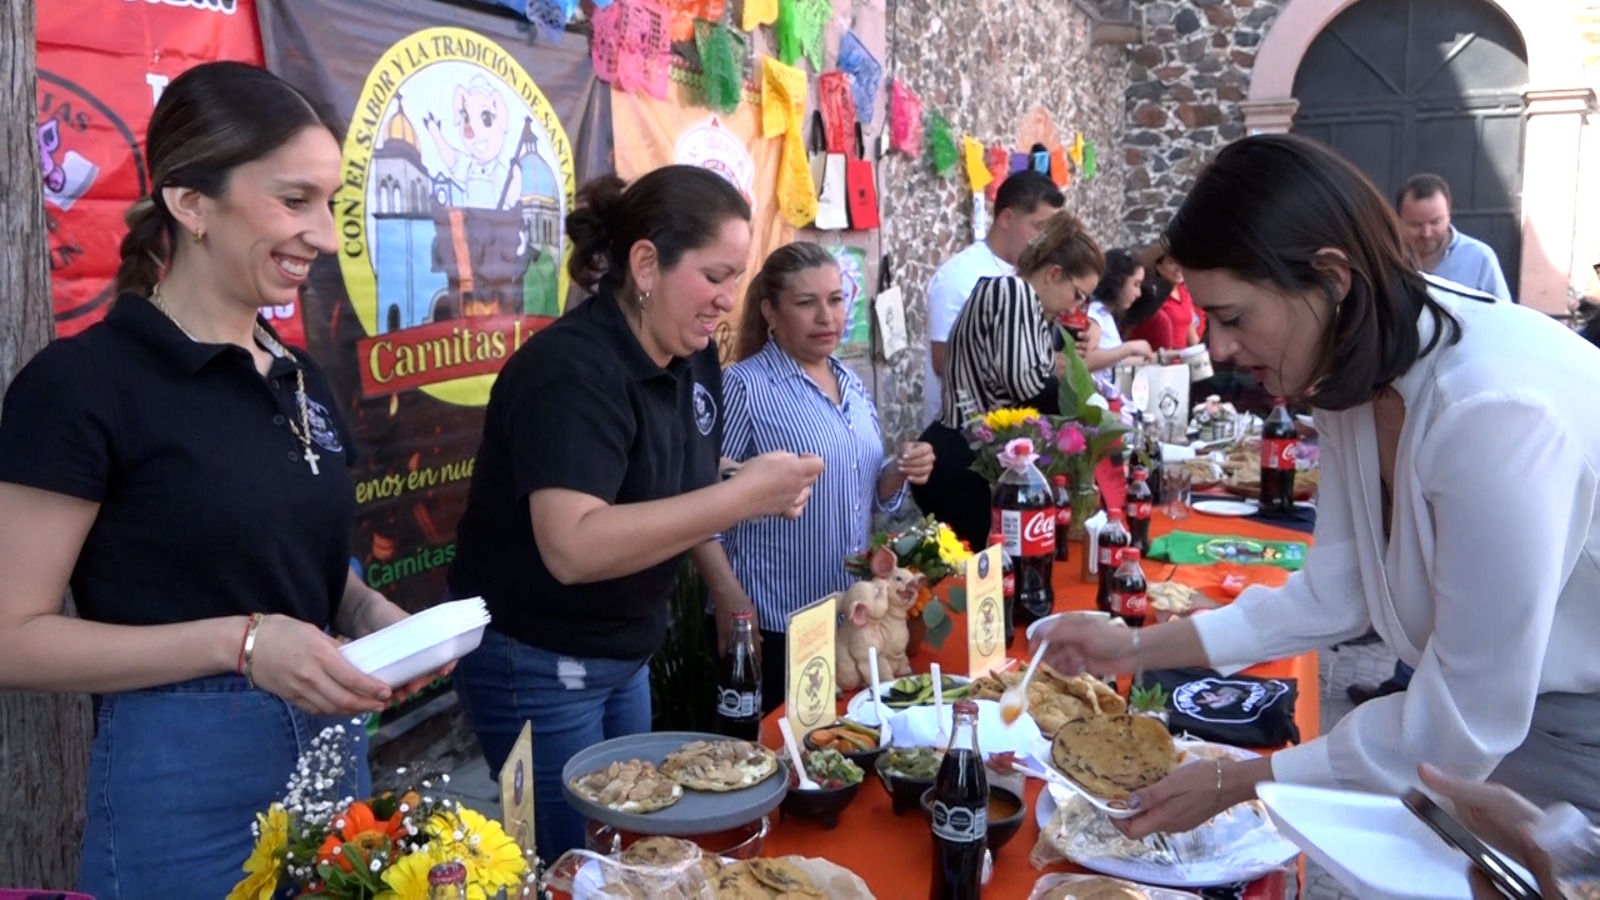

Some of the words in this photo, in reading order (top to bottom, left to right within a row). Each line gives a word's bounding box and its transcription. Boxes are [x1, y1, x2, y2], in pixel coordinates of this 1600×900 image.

[390, 54, 406, 76] Y
[405, 42, 430, 68] LA
[431, 35, 519, 86] TRADICIÓN
[356, 69, 396, 151] SABOR
[521, 82, 543, 114] DE
[540, 111, 574, 183] SANTA
[345, 157, 367, 190] EL
[344, 195, 363, 258] CON
[369, 326, 507, 384] Carnitas
[407, 467, 439, 491] en
[367, 543, 457, 589] Carnitas
